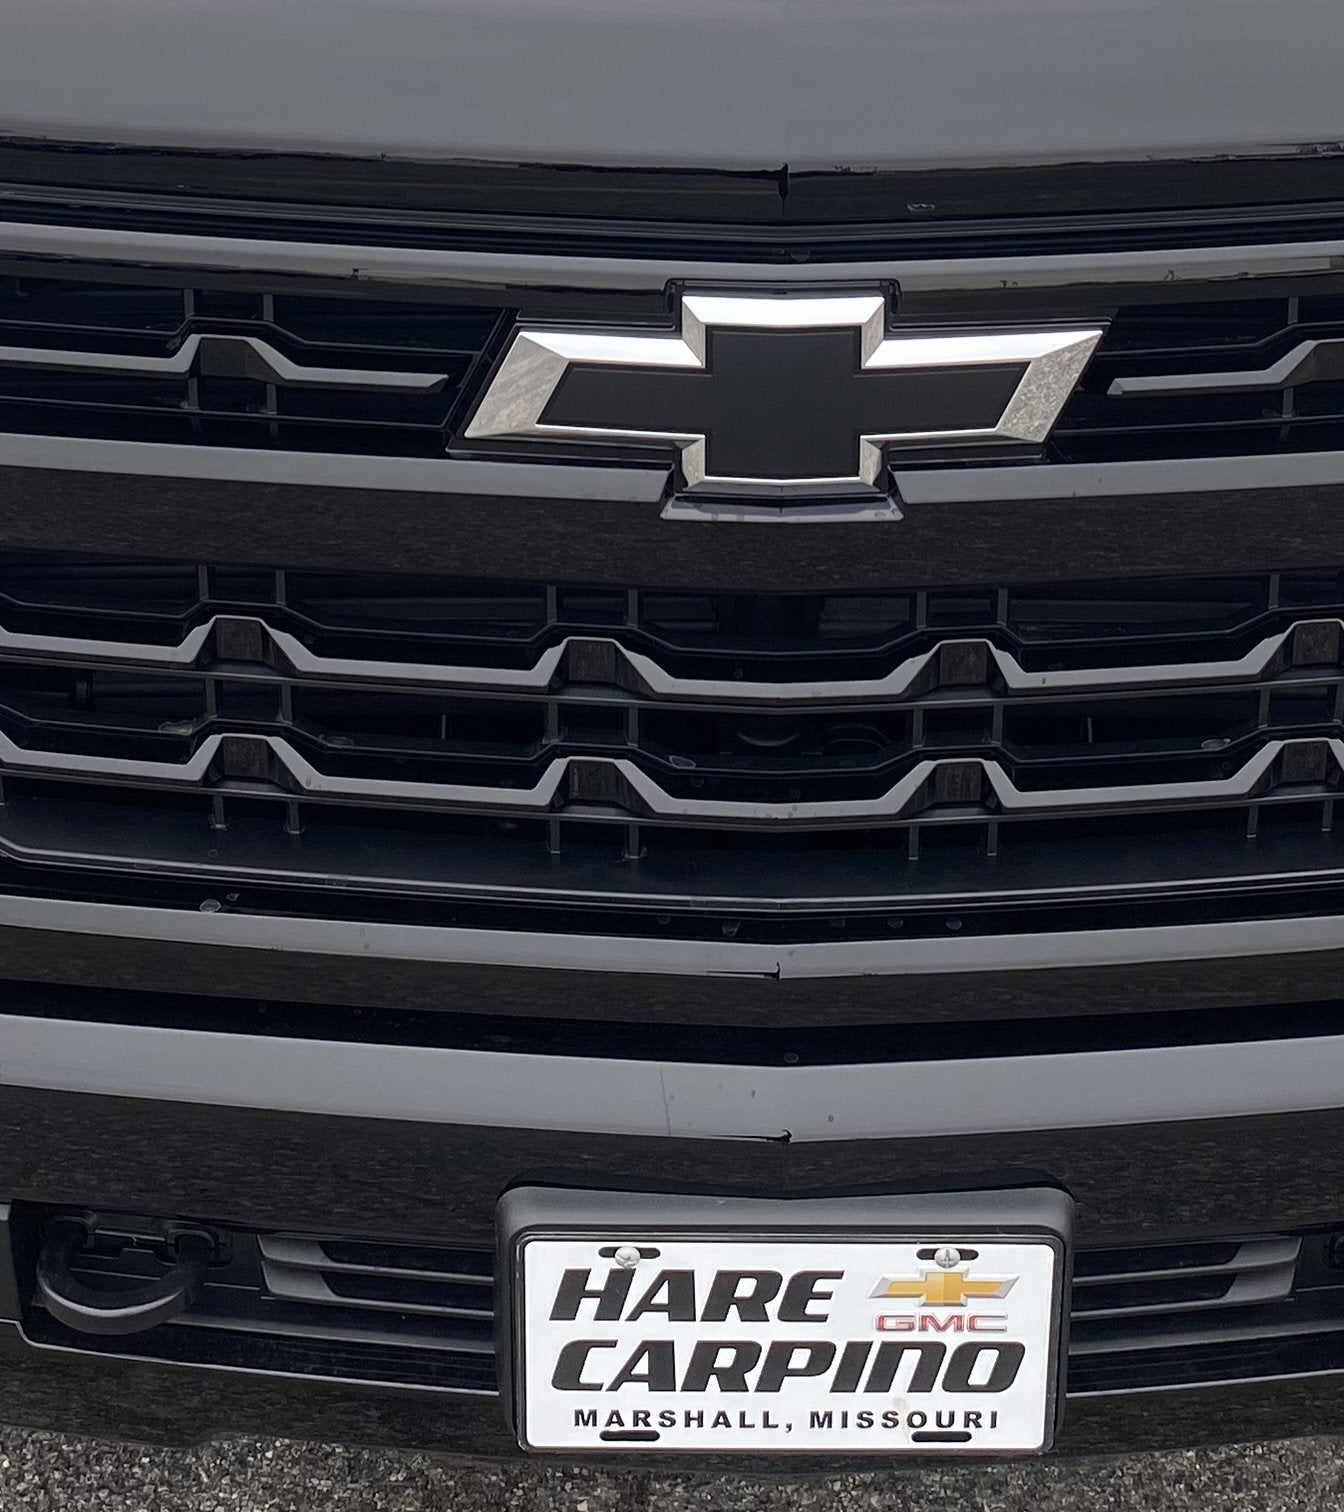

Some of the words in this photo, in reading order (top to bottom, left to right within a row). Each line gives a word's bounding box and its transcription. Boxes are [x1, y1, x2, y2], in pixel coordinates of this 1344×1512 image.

[548, 1268, 845, 1323] HARE
[875, 1312, 1009, 1334] GMC
[550, 1339, 1027, 1393] CARPINO
[573, 1409, 794, 1433] MARSHALL,
[809, 1409, 999, 1430] MISSOURI
